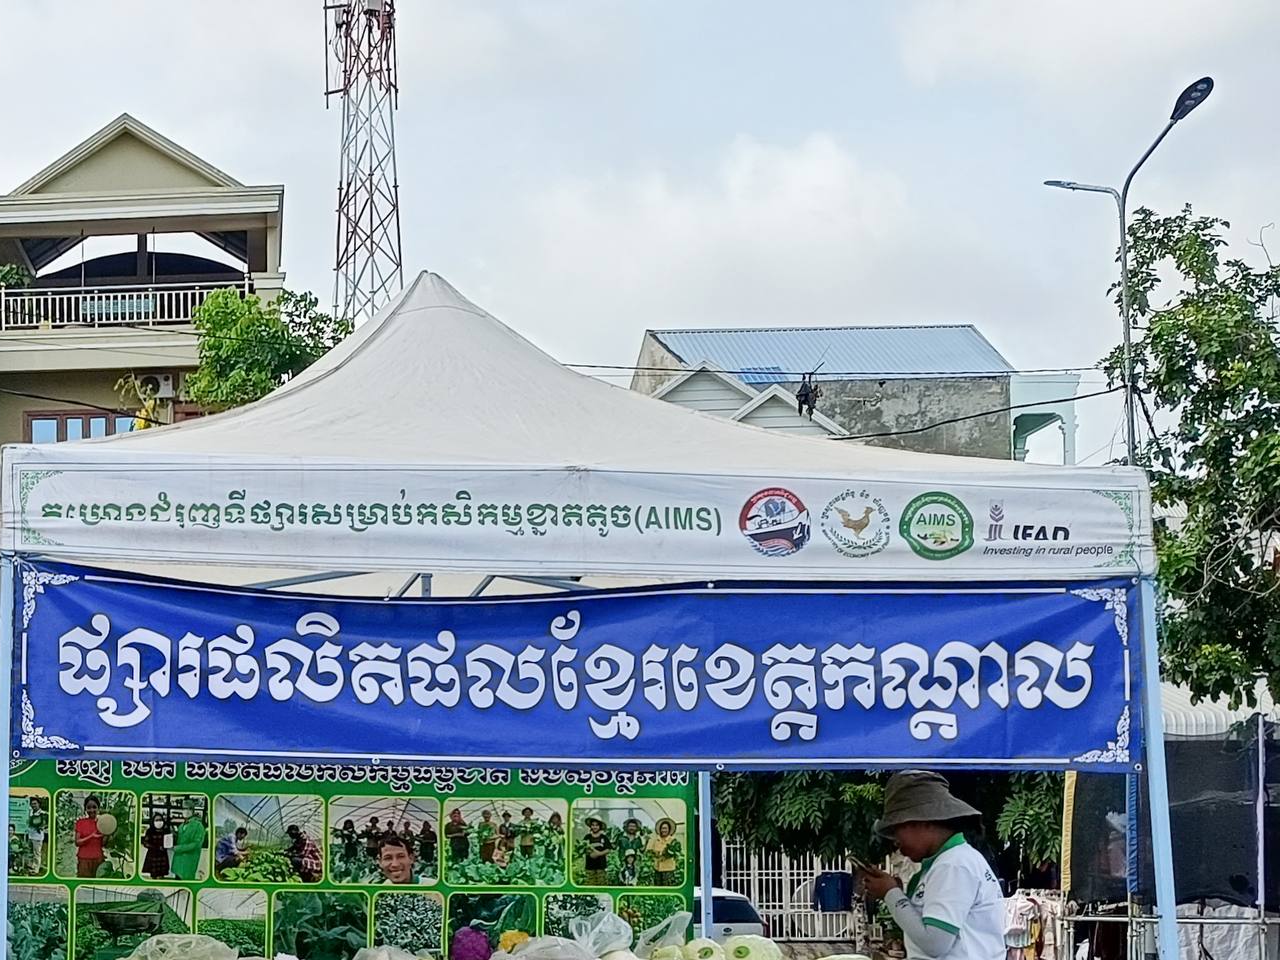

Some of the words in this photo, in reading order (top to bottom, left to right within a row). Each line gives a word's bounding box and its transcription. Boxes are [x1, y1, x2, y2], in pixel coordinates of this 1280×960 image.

[916, 513, 956, 527] AIMS
[1013, 524, 1071, 540] IFAD
[983, 545, 1033, 557] Investing
[1035, 546, 1046, 555] in
[1048, 545, 1073, 556] rural
[1075, 545, 1114, 557] people
